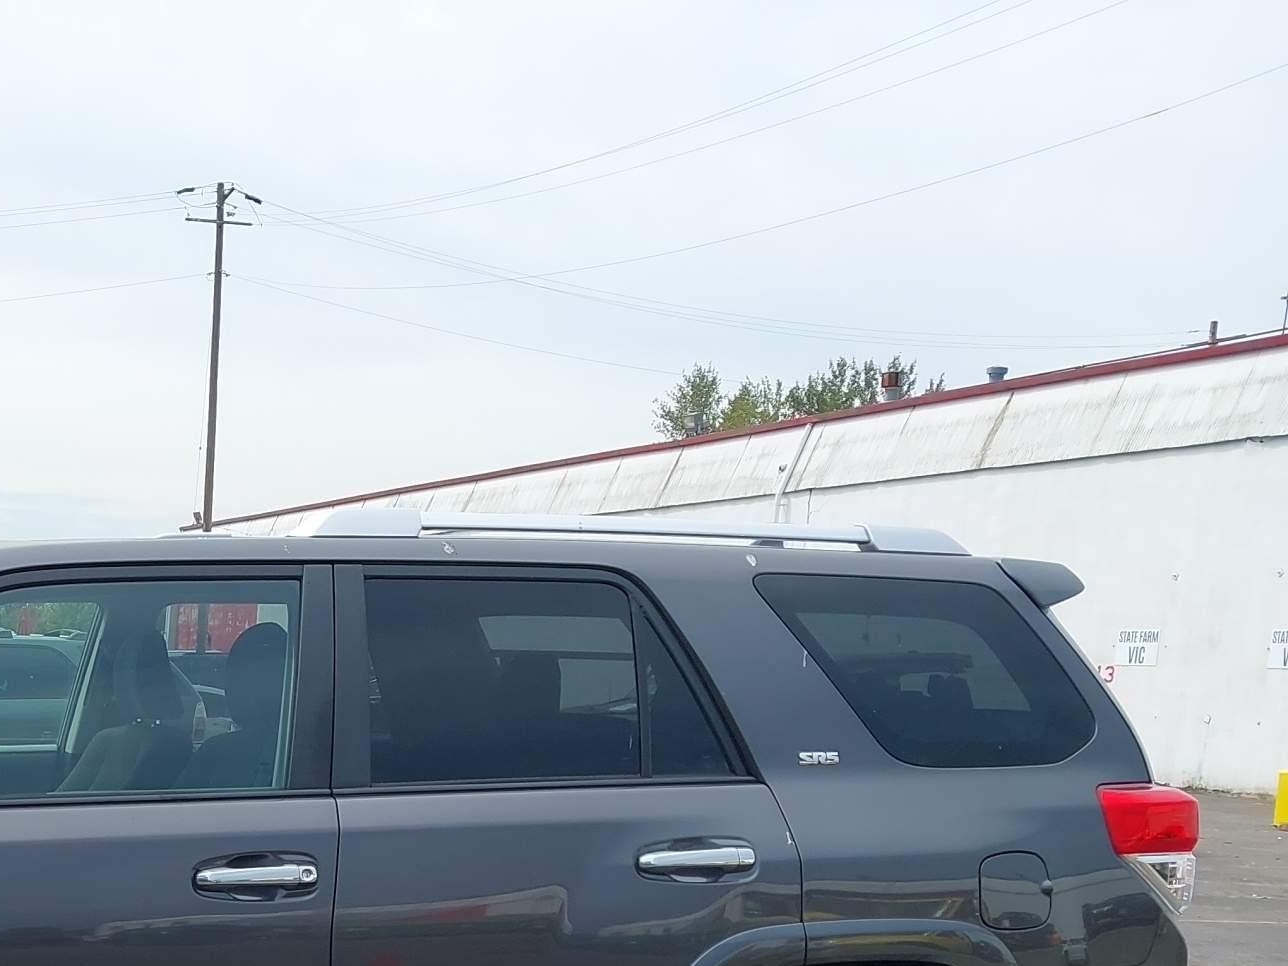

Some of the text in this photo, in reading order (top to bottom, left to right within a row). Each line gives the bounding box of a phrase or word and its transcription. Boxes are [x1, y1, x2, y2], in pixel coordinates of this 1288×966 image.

[1118, 630, 1159, 643] STATE FARM
[1128, 646, 1146, 664] VIC
[798, 751, 840, 765] SR5
